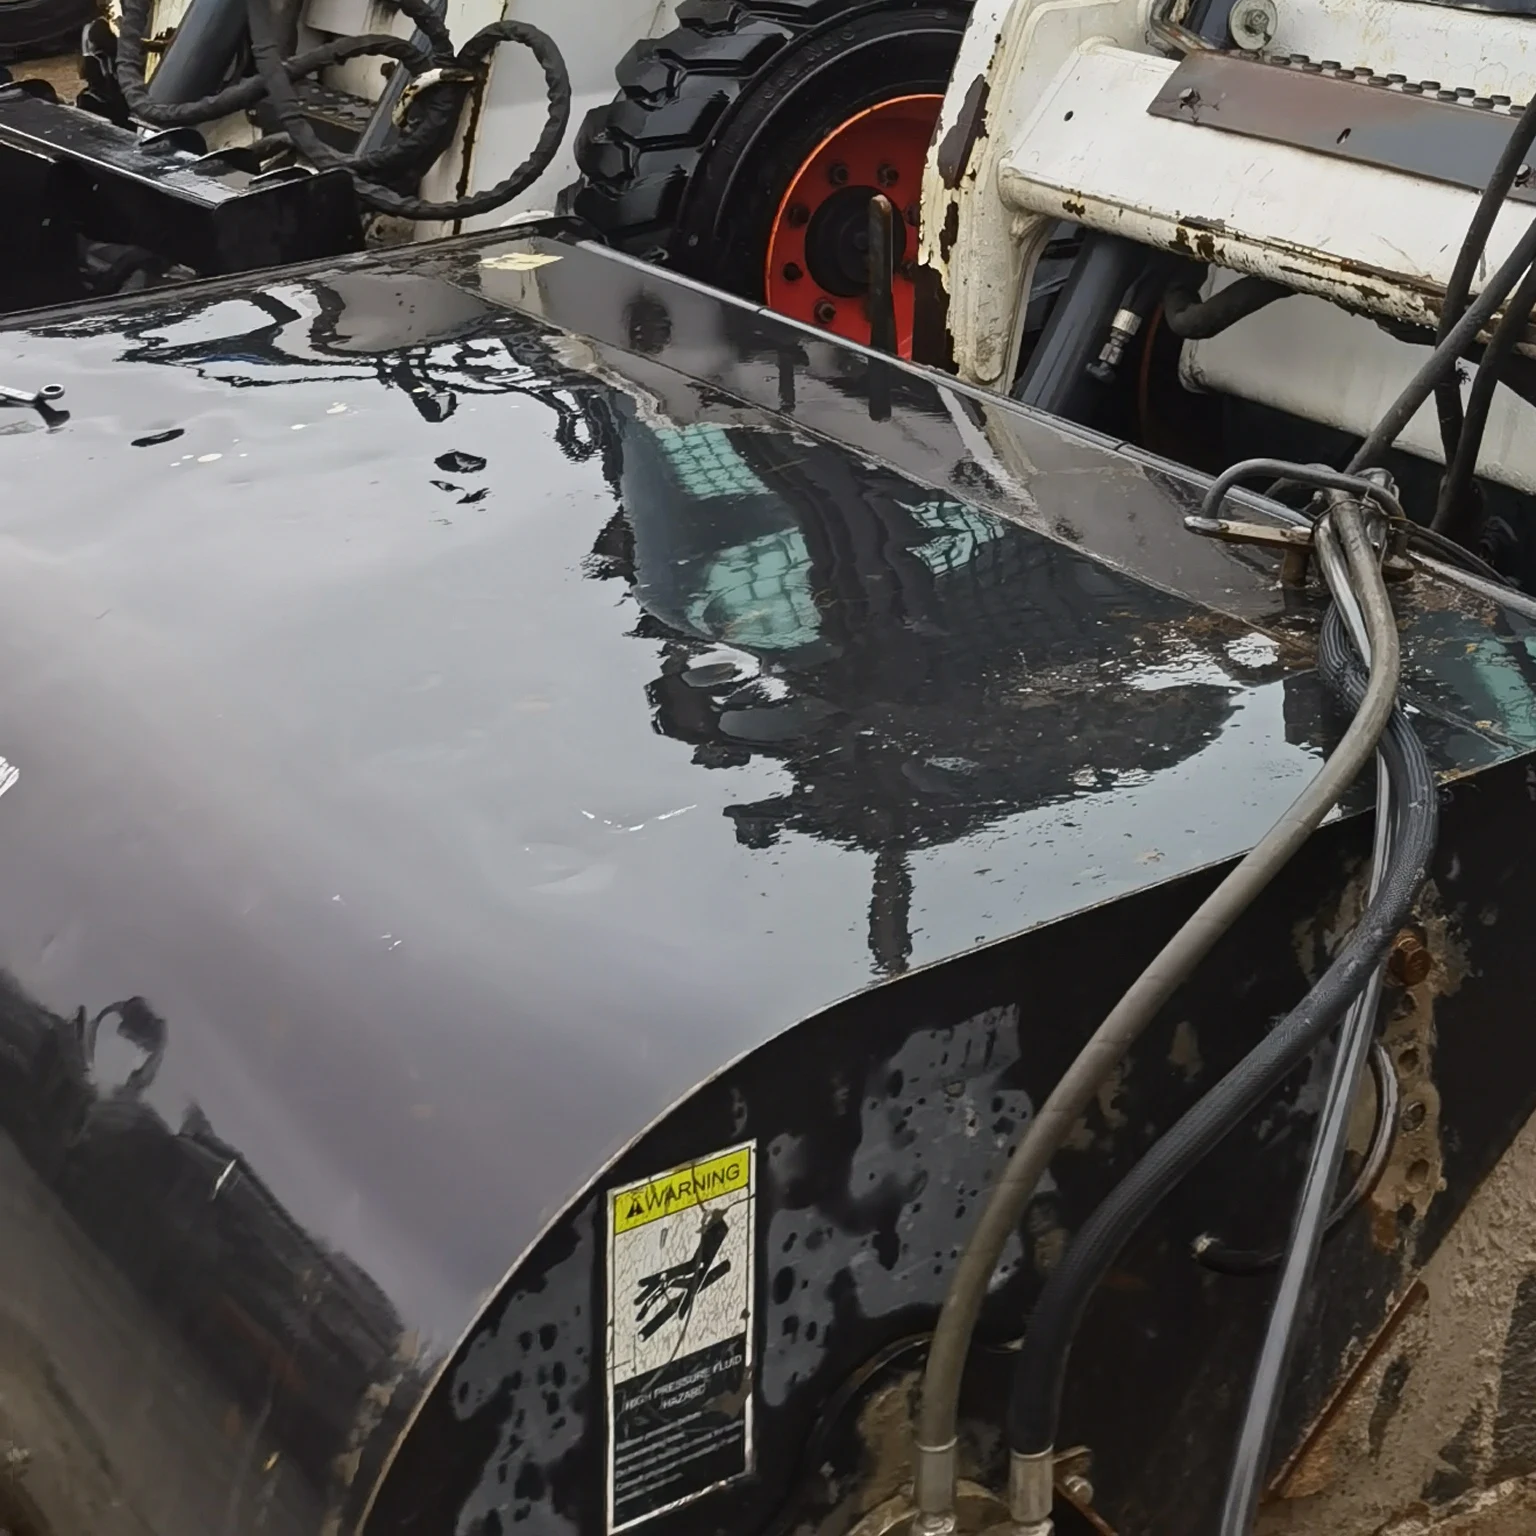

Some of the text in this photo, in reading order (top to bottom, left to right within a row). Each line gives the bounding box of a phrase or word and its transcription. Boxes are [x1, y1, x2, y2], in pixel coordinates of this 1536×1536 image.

[645, 1164, 740, 1211] WARNING
[654, 1368, 710, 1399] PRESSURE
[713, 1355, 742, 1374] FLUID
